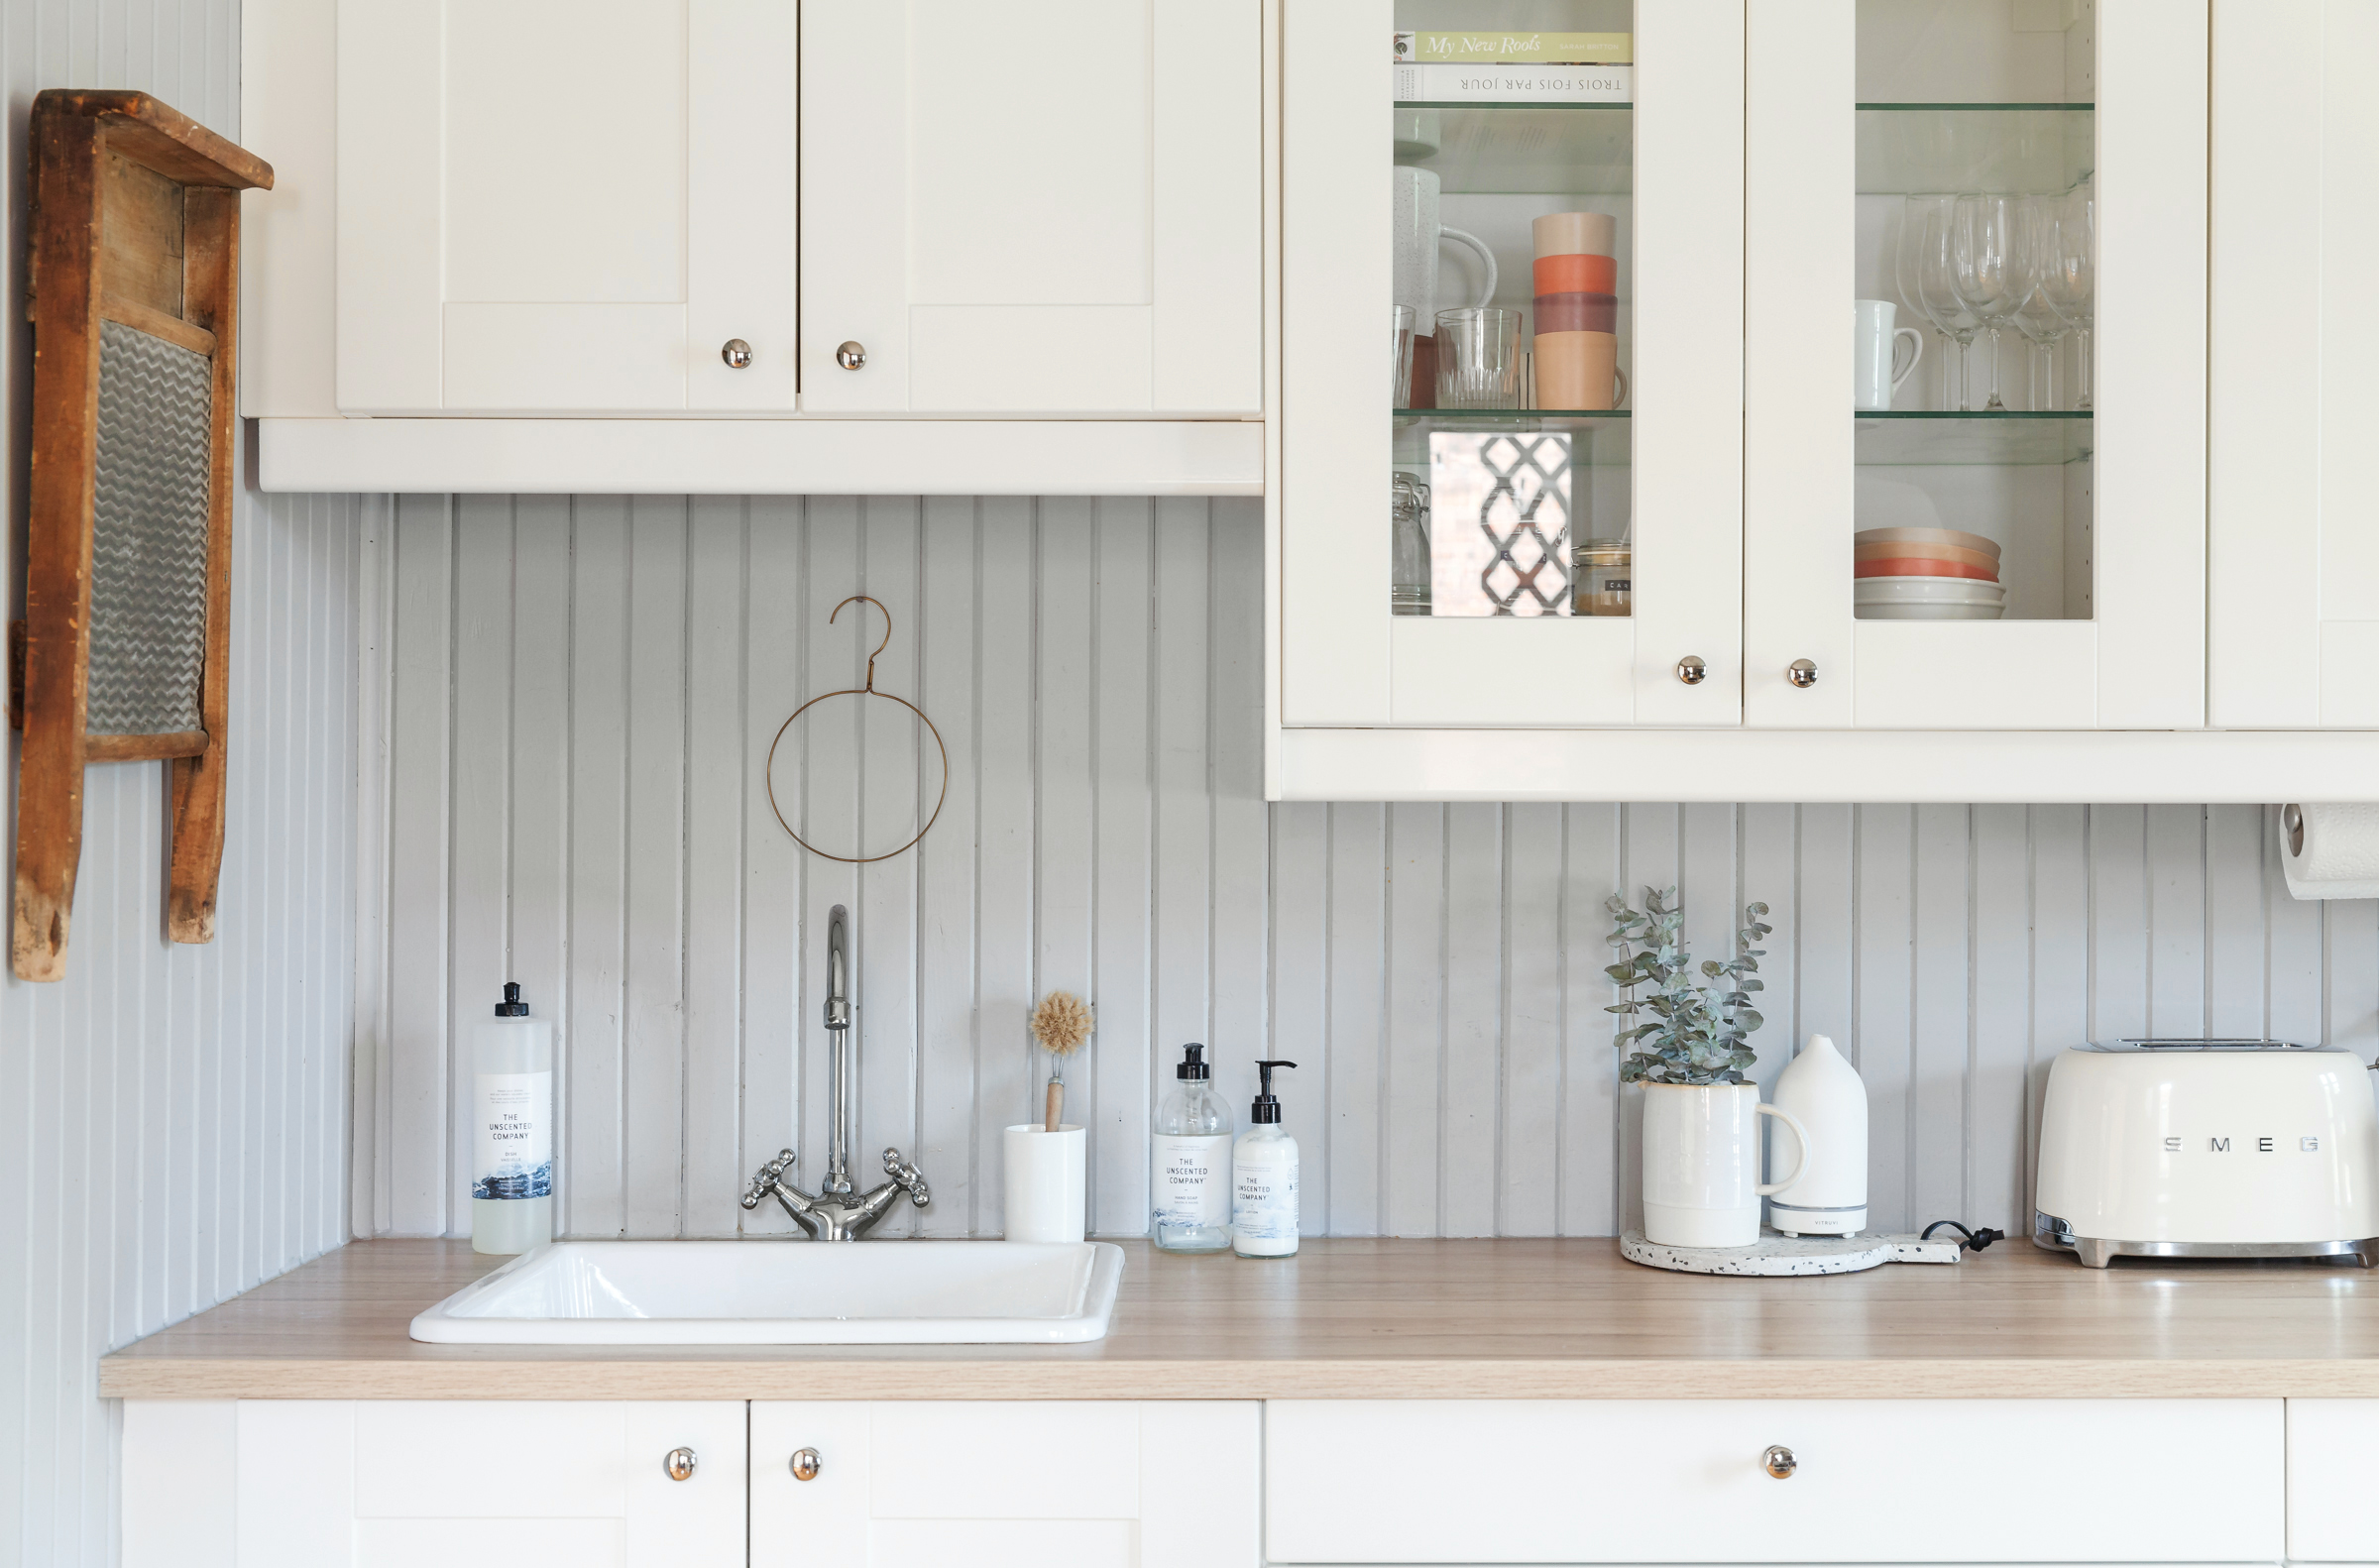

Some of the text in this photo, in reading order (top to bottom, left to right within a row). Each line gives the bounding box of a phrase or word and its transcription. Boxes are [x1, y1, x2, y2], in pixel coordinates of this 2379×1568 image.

[1424, 34, 1540, 58] My New Roots
[1460, 77, 1622, 90] TROIS FOIS PAR JOUR
[2164, 1136, 2319, 1152] SMEG
[1237, 1184, 1271, 1193] UNSCENTED
